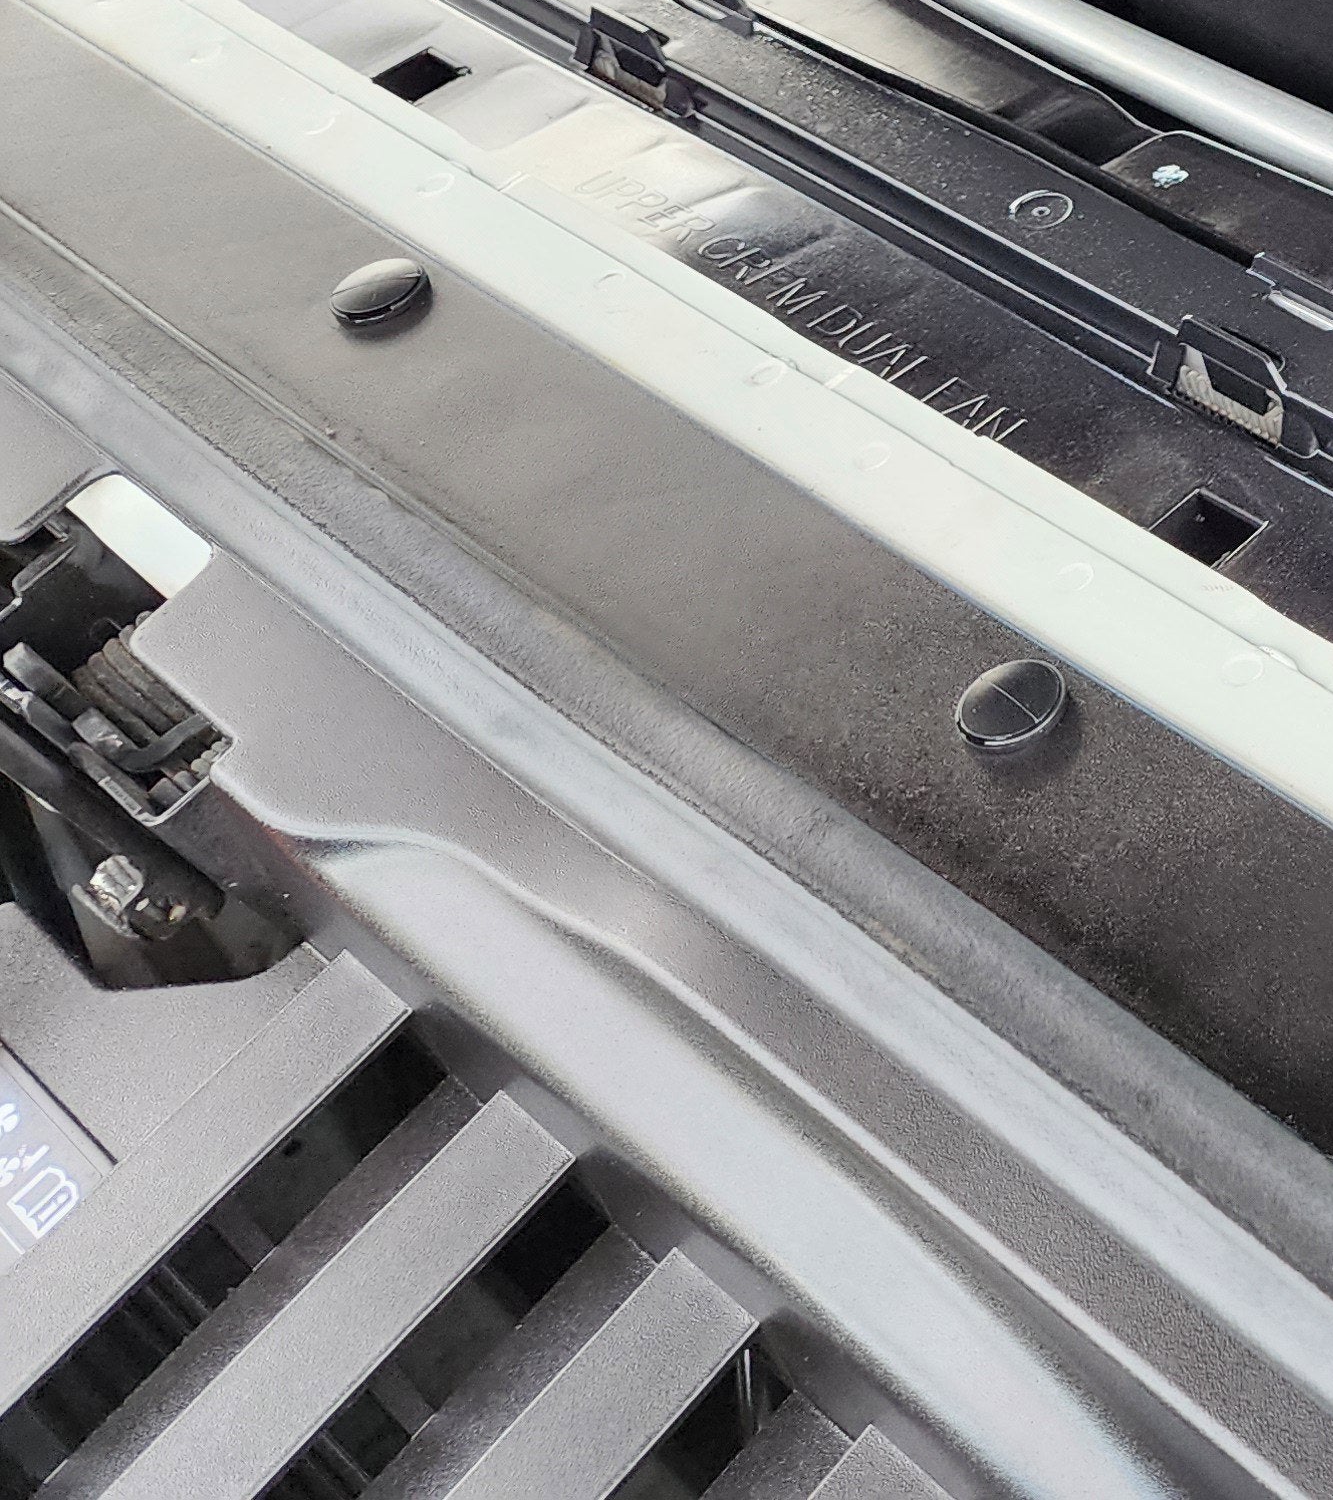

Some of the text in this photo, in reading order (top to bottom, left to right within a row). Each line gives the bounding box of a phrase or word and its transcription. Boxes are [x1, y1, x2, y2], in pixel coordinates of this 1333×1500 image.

[575, 170, 717, 244] UPPER
[806, 303, 930, 383] DUAL
[919, 376, 1029, 442] FAN
